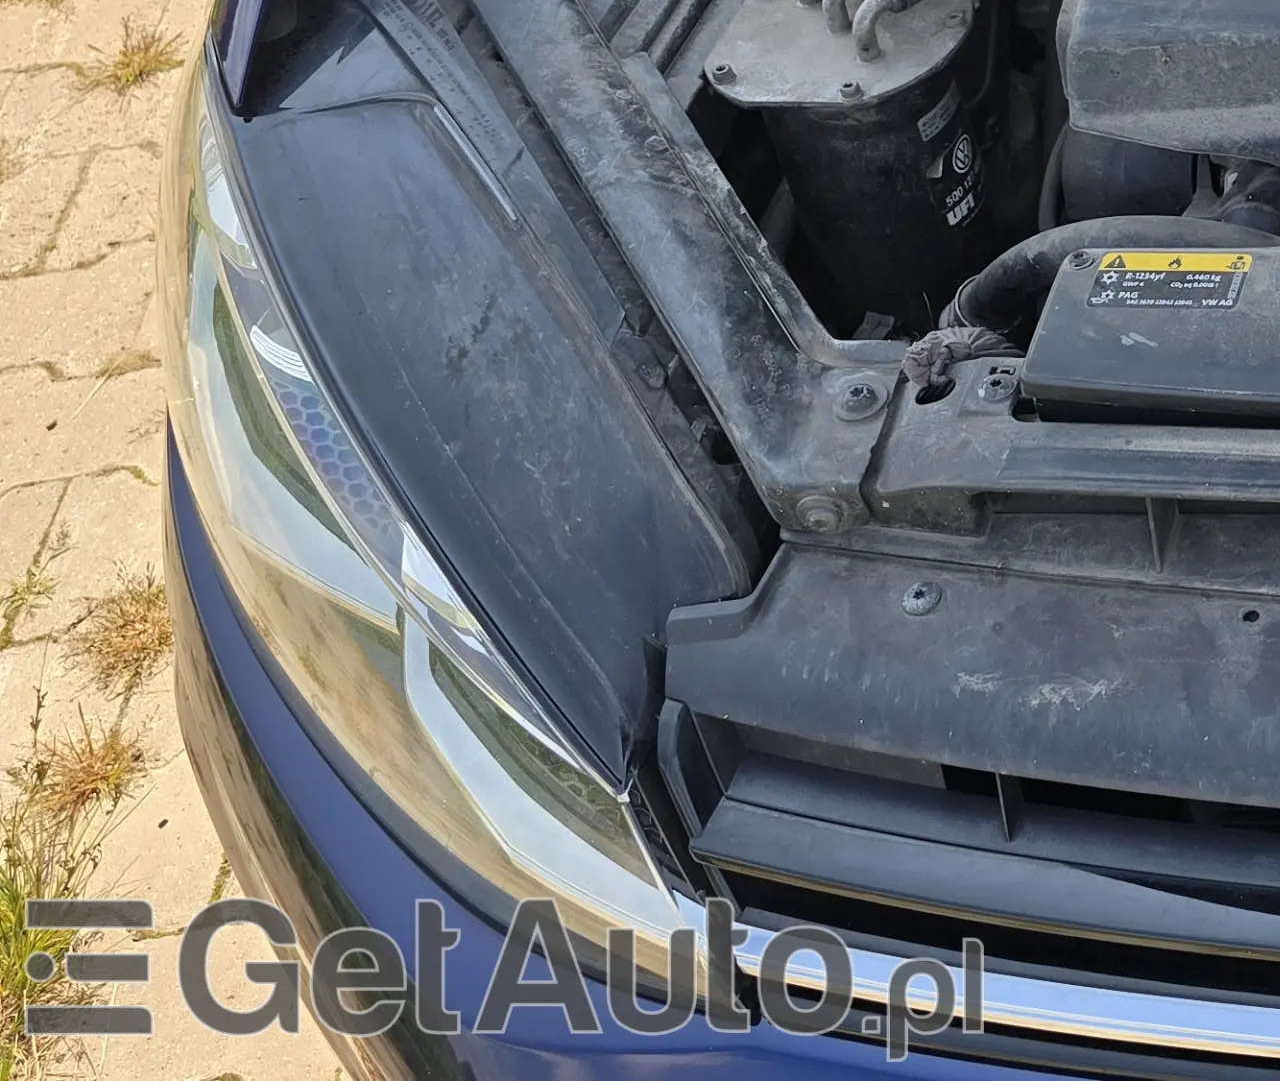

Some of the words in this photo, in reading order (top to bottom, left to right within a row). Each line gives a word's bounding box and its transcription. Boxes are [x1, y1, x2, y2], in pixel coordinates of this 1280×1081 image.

[946, 193, 975, 226] UFI
[1125, 272, 1166, 281] R-1234yf
[1118, 291, 1139, 299] PAG
